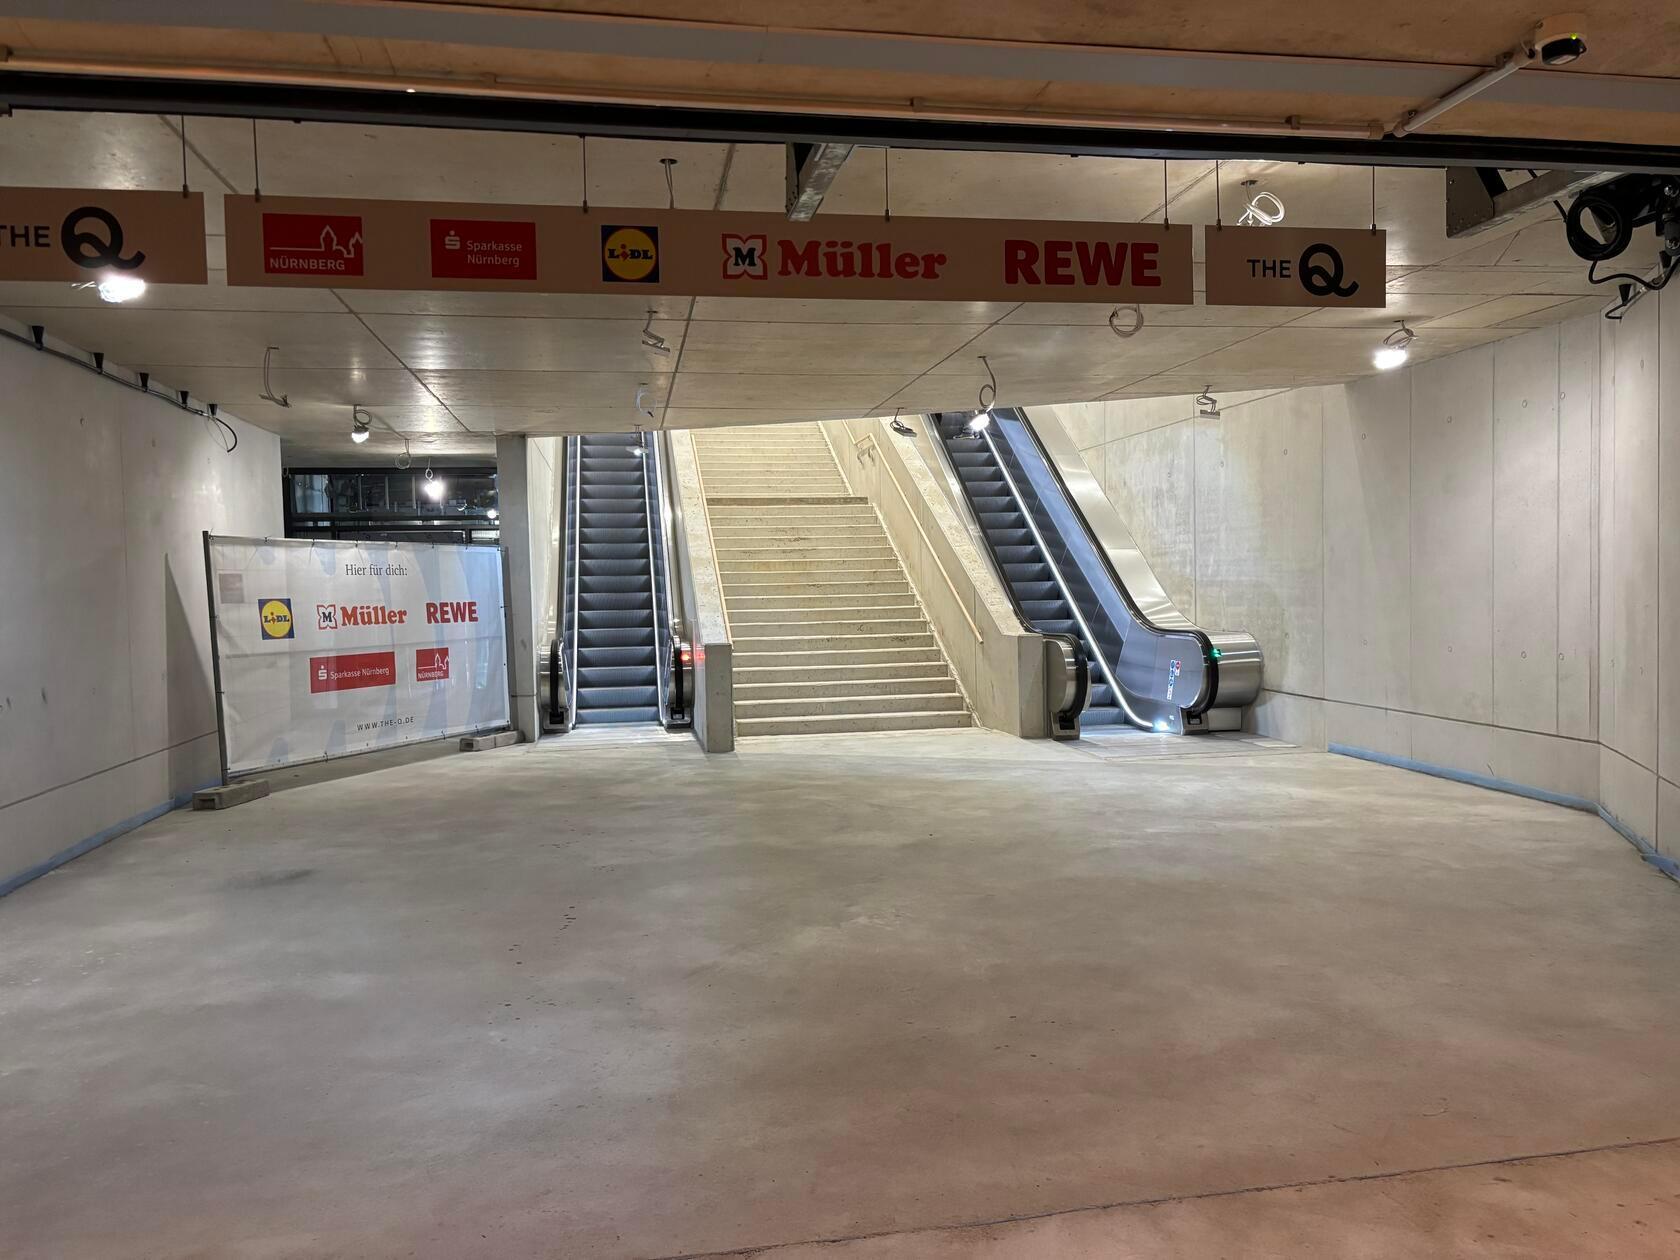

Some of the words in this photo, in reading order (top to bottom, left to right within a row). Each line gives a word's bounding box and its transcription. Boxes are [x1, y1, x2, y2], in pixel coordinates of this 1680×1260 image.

[61, 206, 146, 270] Q
[466, 240, 523, 252] Sparkasse
[269, 256, 346, 271] NÜRNBERG
[467, 254, 520, 268] Nürnberg
[777, 239, 947, 280] Müller
[1004, 240, 1161, 287] REWE
[1246, 258, 1292, 279] THE
[1299, 243, 1360, 297] Q
[345, 564, 368, 576] Hier
[369, 564, 383, 577] für
[385, 564, 408, 577] dich:
[340, 604, 407, 626] Müller
[426, 601, 479, 624] REWE
[330, 669, 361, 680] Sparkasse
[361, 666, 390, 677] Nürnberg
[356, 716, 414, 731] WWW.THE-Q.DE
